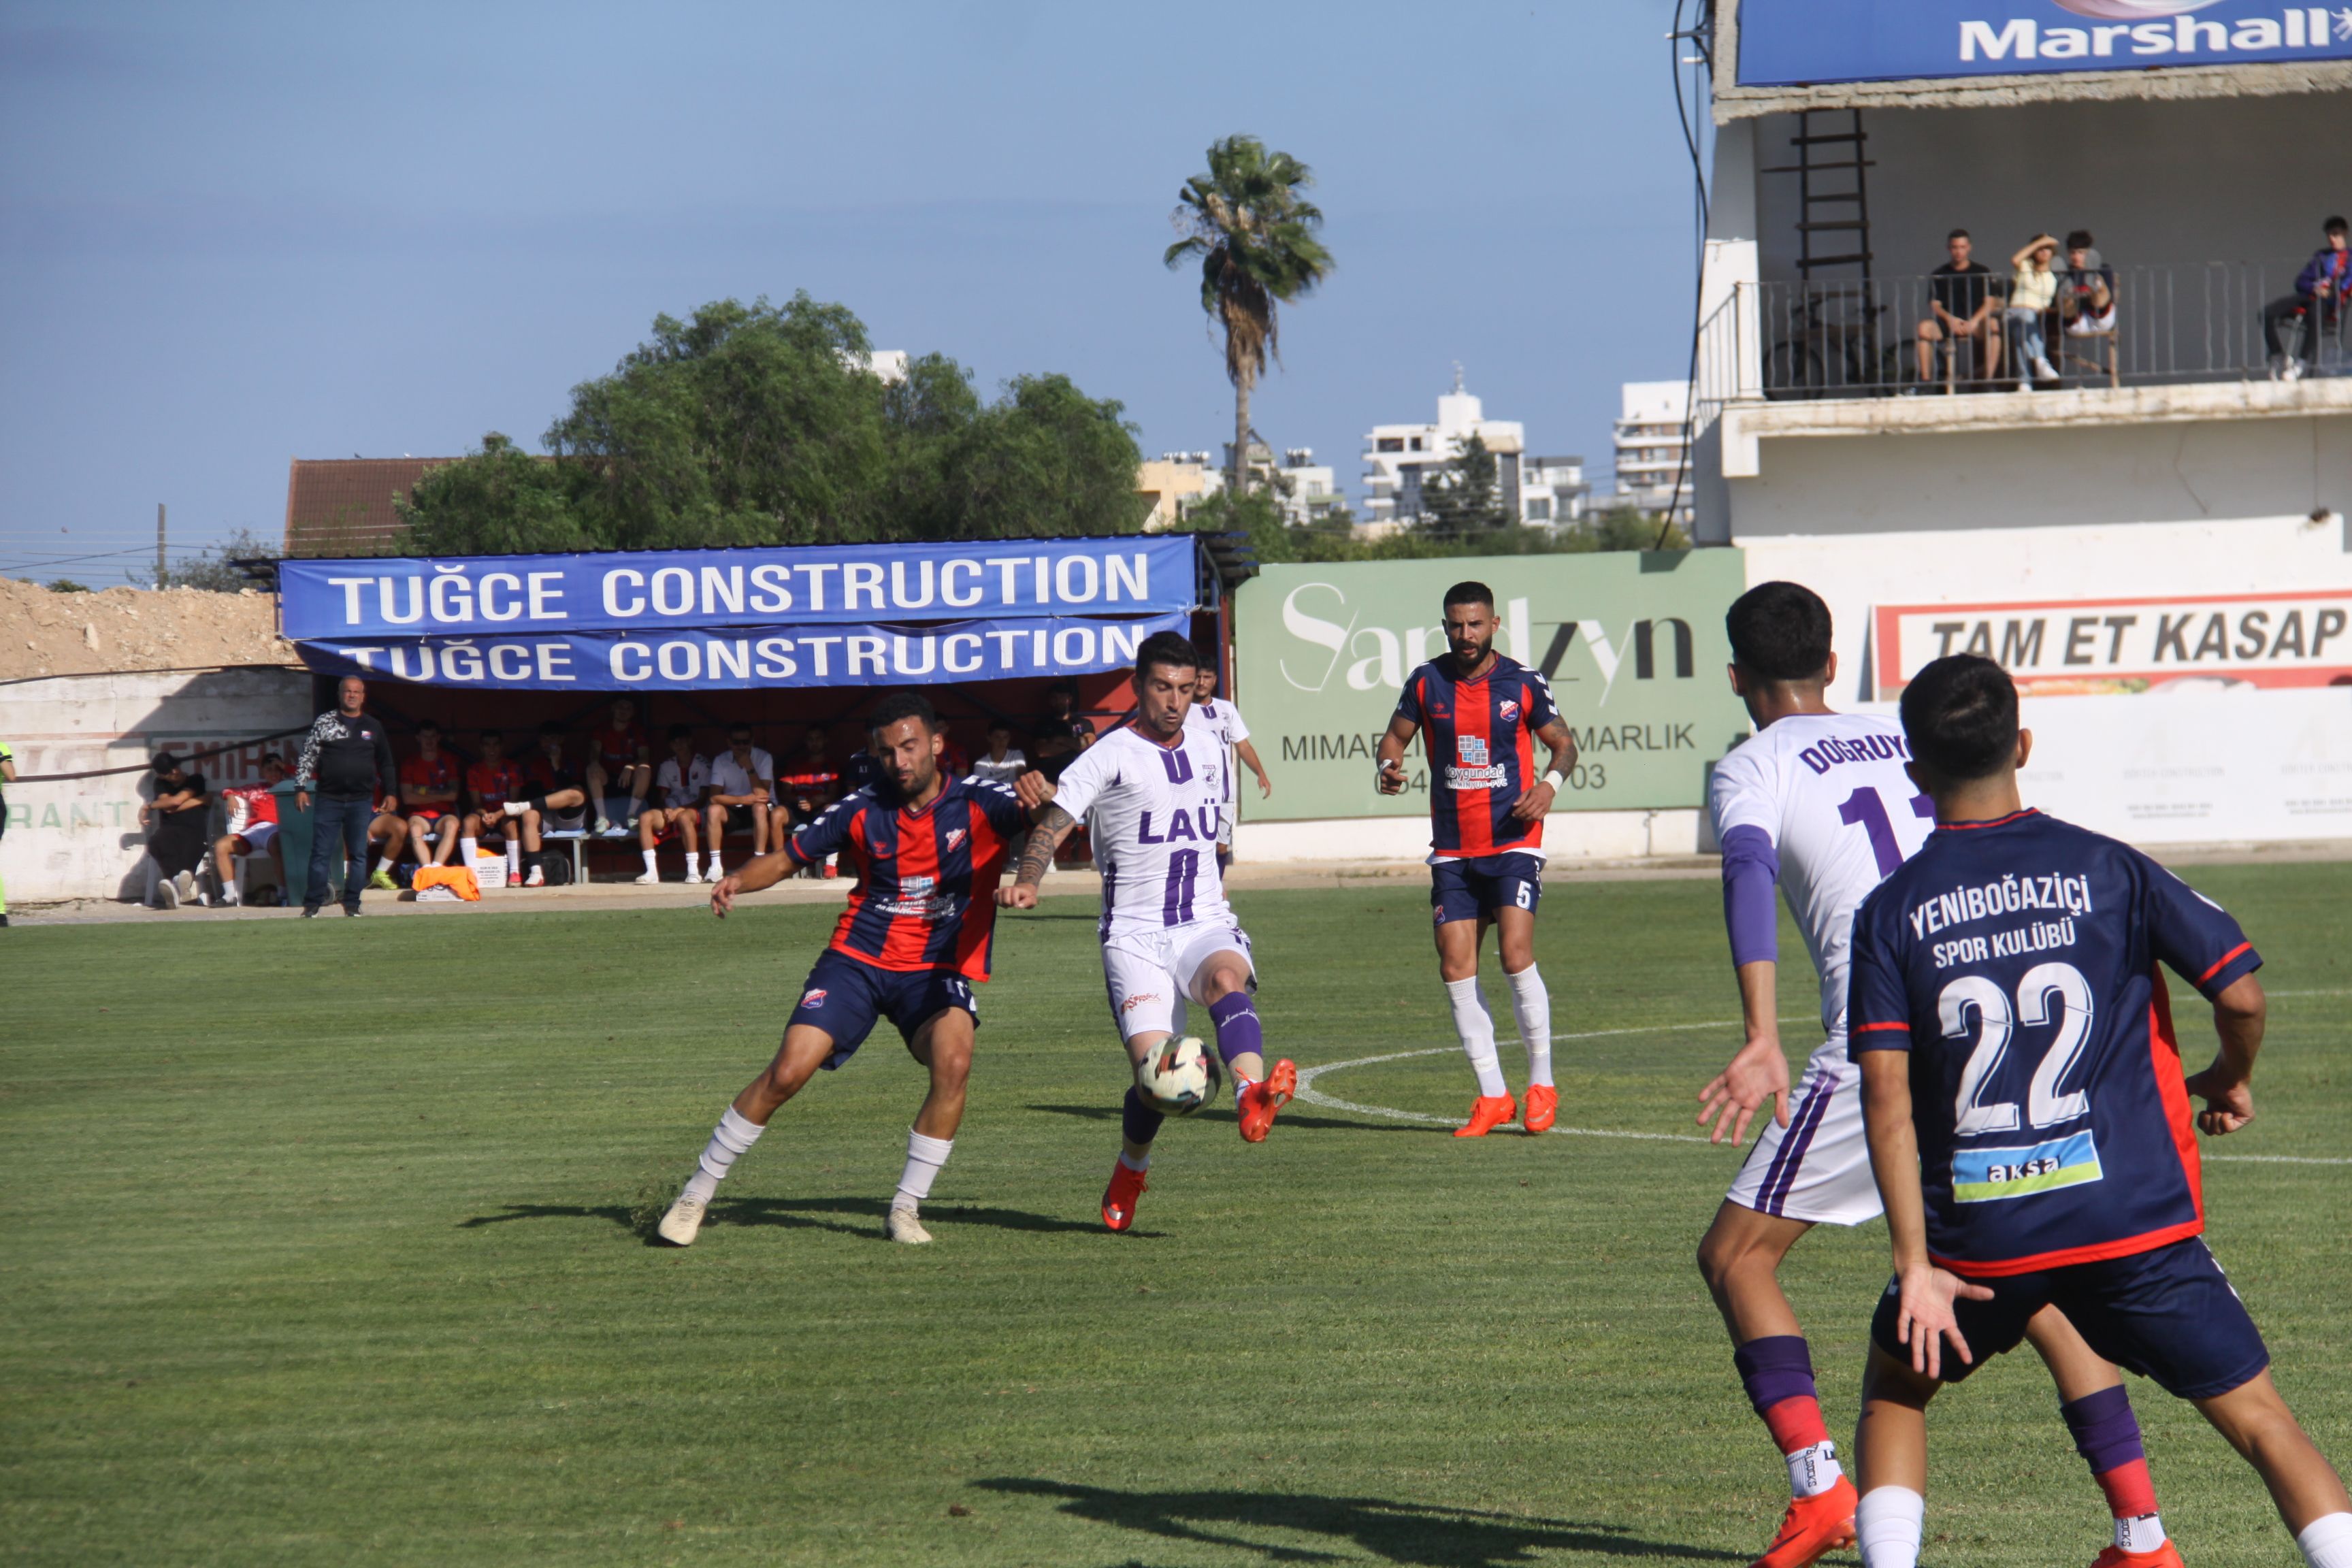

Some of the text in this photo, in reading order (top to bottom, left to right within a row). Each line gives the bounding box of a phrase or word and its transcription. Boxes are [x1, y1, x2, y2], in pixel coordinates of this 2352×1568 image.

[1959, 7, 2330, 61] Marshall
[327, 553, 1149, 625] TUĞCE CONSTRUCTION
[339, 624, 1145, 681] TUĞCE CONSTRUCTION
[1931, 609, 2347, 667] TAM ET KASAP
[1799, 734, 1911, 775] DOĞRUY
[1137, 798, 1221, 845] LAÜ
[1515, 880, 1532, 911] 5
[1909, 872, 2093, 942] YENİBOĞAZİÇİ
[1932, 915, 2077, 969] SPOR KULÜBÜ
[1938, 962, 2095, 1137] 22
[1988, 1156, 2061, 1183] aksa
